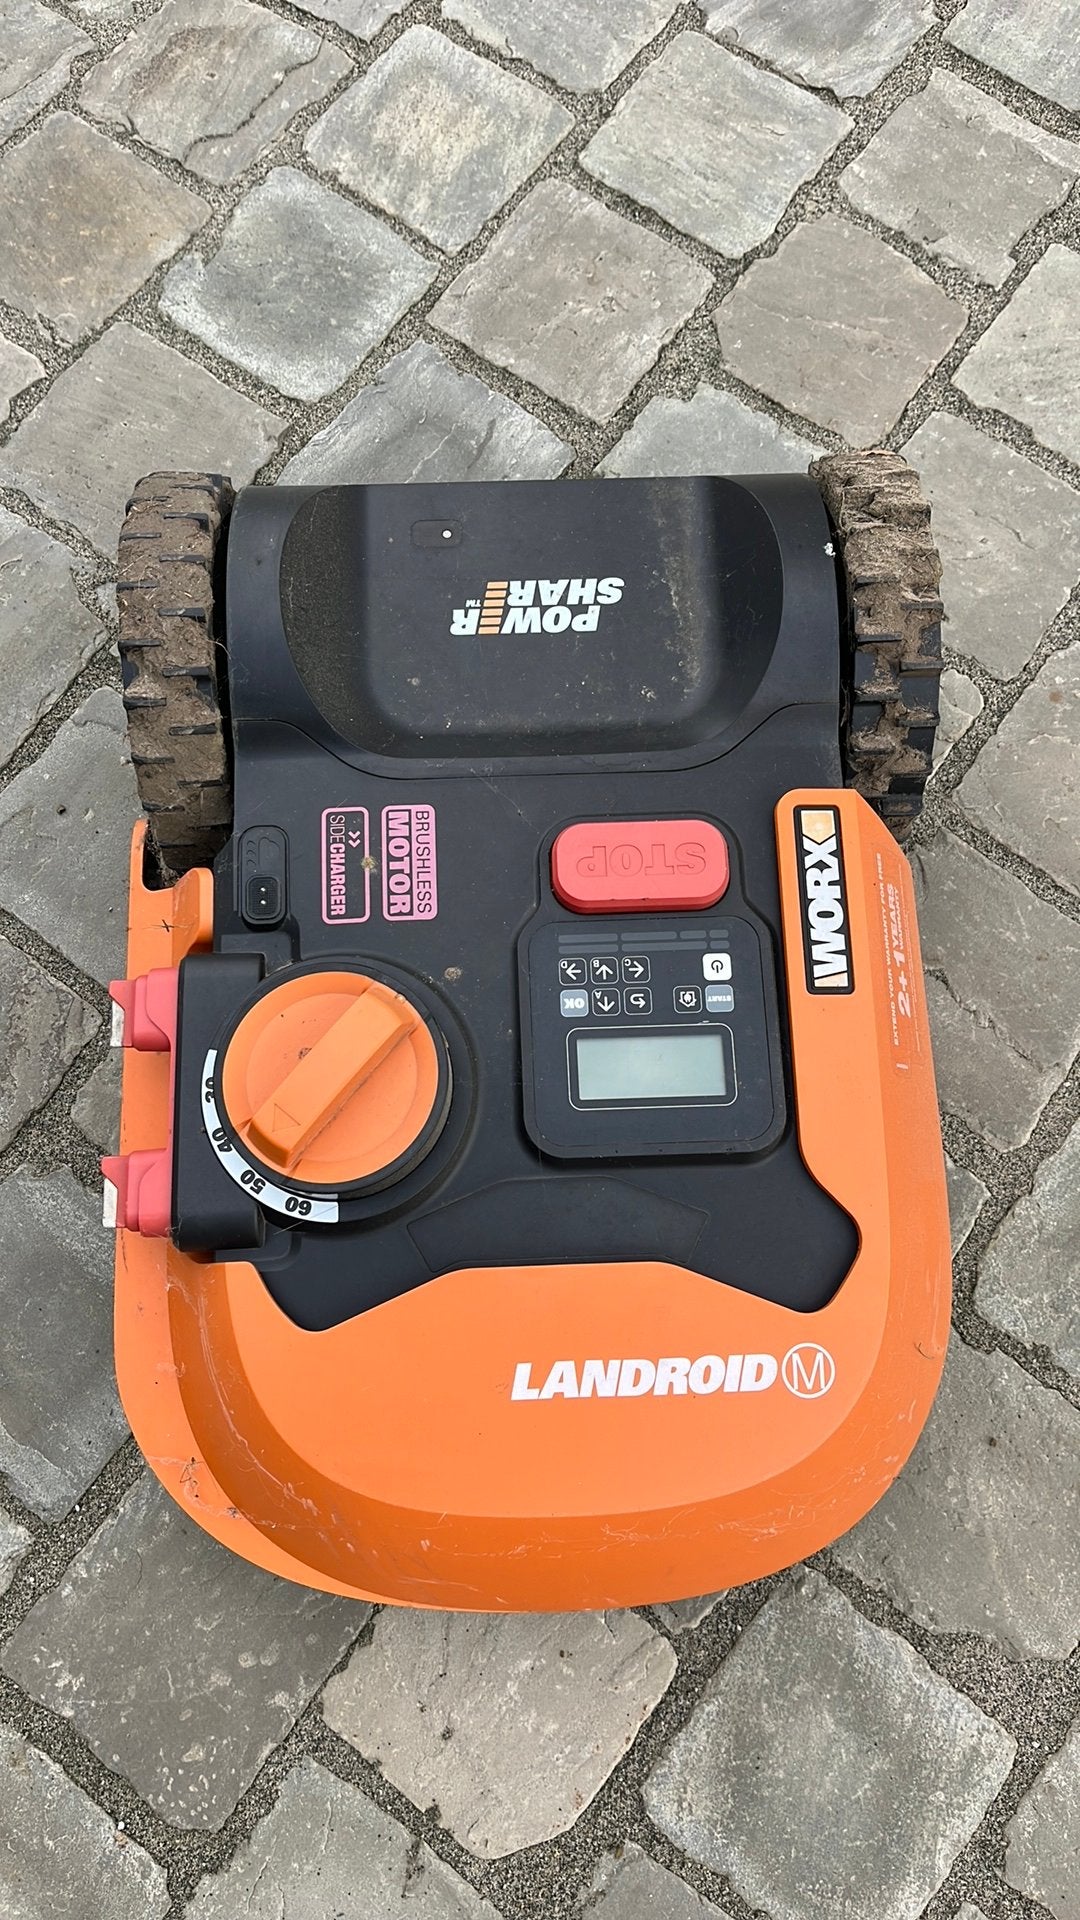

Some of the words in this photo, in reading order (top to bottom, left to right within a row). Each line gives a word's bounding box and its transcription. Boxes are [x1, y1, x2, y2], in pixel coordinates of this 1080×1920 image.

[388, 811, 411, 914] MOTOR
[415, 810, 432, 913] BRUSHLESS
[576, 842, 707, 877] STOP
[802, 835, 848, 979] WORX
[887, 883, 899, 948] YEARS
[894, 887, 904, 950] WARRANTY
[881, 905, 891, 966] WARRANTY
[560, 960, 568, 969] D
[592, 959, 600, 968] B
[624, 958, 632, 967] C
[594, 991, 602, 999] A
[887, 968, 895, 998] YOUR
[563, 997, 585, 1009] OK
[707, 995, 732, 1003] START
[890, 1001, 899, 1046] EXTEND
[211, 1127, 233, 1153] 40
[240, 1169, 267, 1195] 50
[284, 1196, 313, 1216] 60
[510, 1353, 779, 1400] LANDROID
